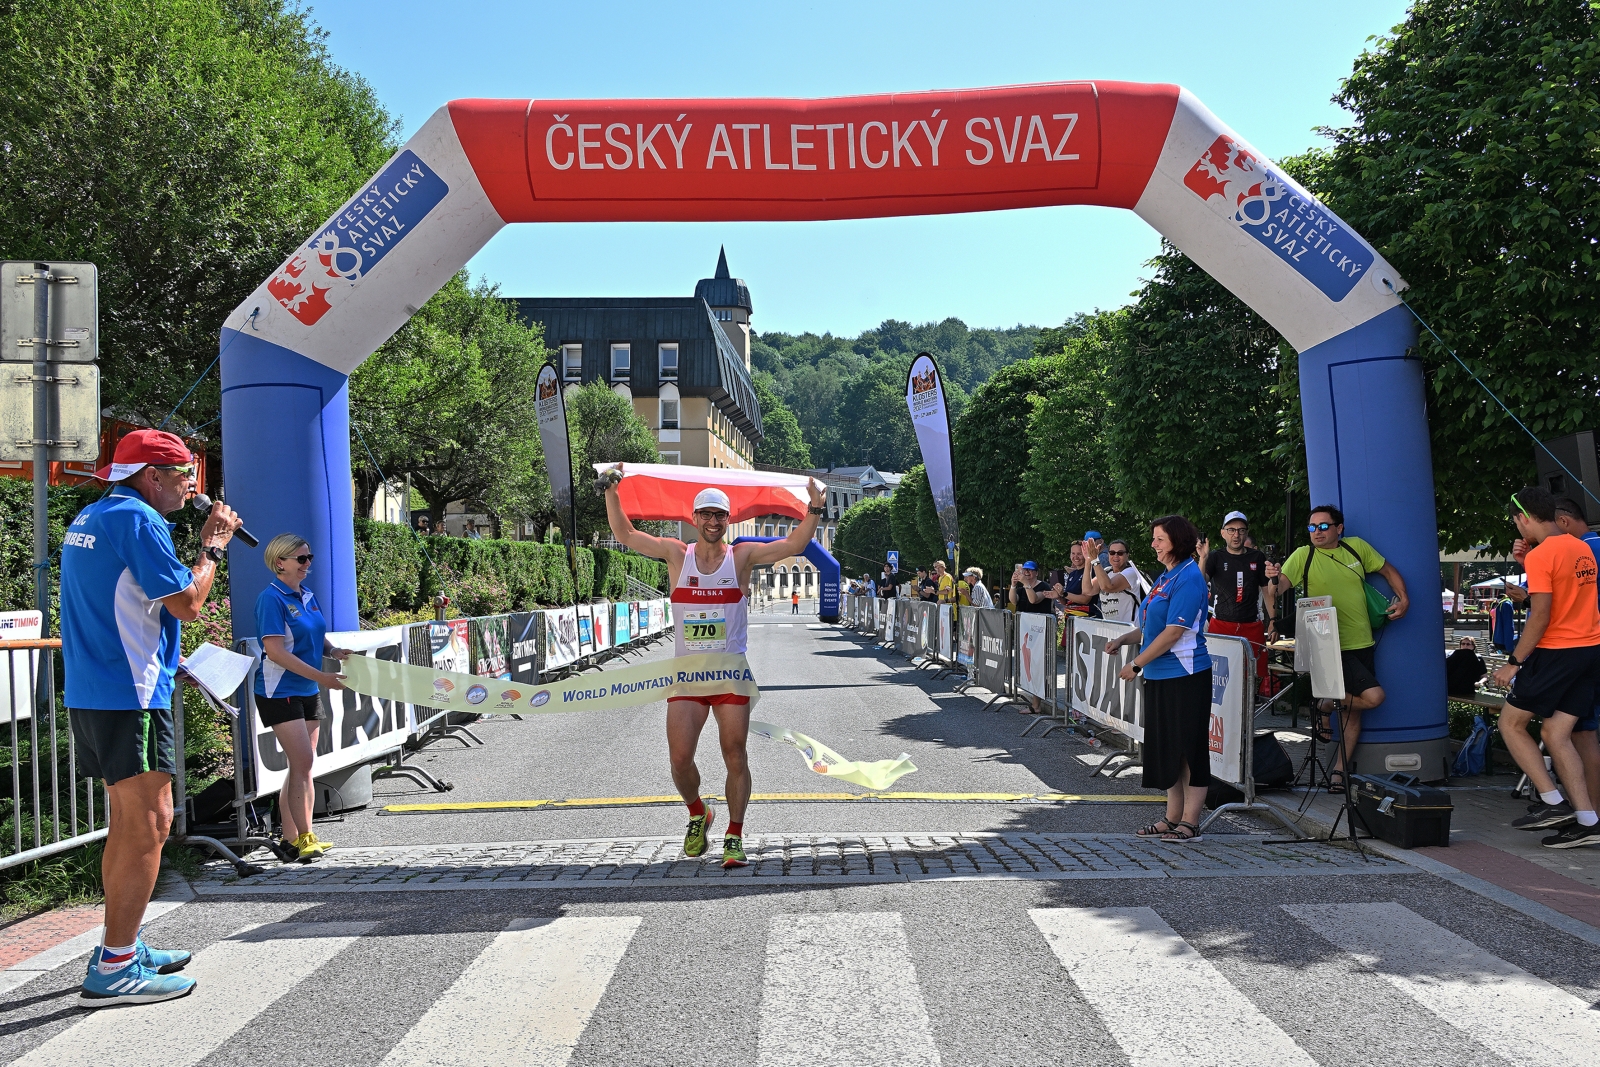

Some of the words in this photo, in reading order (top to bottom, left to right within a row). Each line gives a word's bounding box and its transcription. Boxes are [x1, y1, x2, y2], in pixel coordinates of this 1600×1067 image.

[545, 114, 693, 171] ČESKÝ
[705, 109, 948, 171] ATLETICKÝ
[965, 113, 1080, 166] SVAZ
[336, 185, 381, 231] ČESKÝ
[349, 162, 426, 244] ATLETICKÝ
[1288, 193, 1338, 236] ČESKÝ
[361, 214, 406, 258] SVAZ
[1262, 222, 1309, 263] SVAZ
[1275, 208, 1363, 279] ATLETICKÝ
[912, 389, 937, 402] KLOSTERS
[0, 617, 39, 629] INETIMING
[692, 624, 716, 637] 770
[563, 687, 607, 703] WORLD
[610, 675, 674, 696] MOUNTAIN
[676, 669, 740, 683] RUNNING
[742, 669, 754, 682] A
